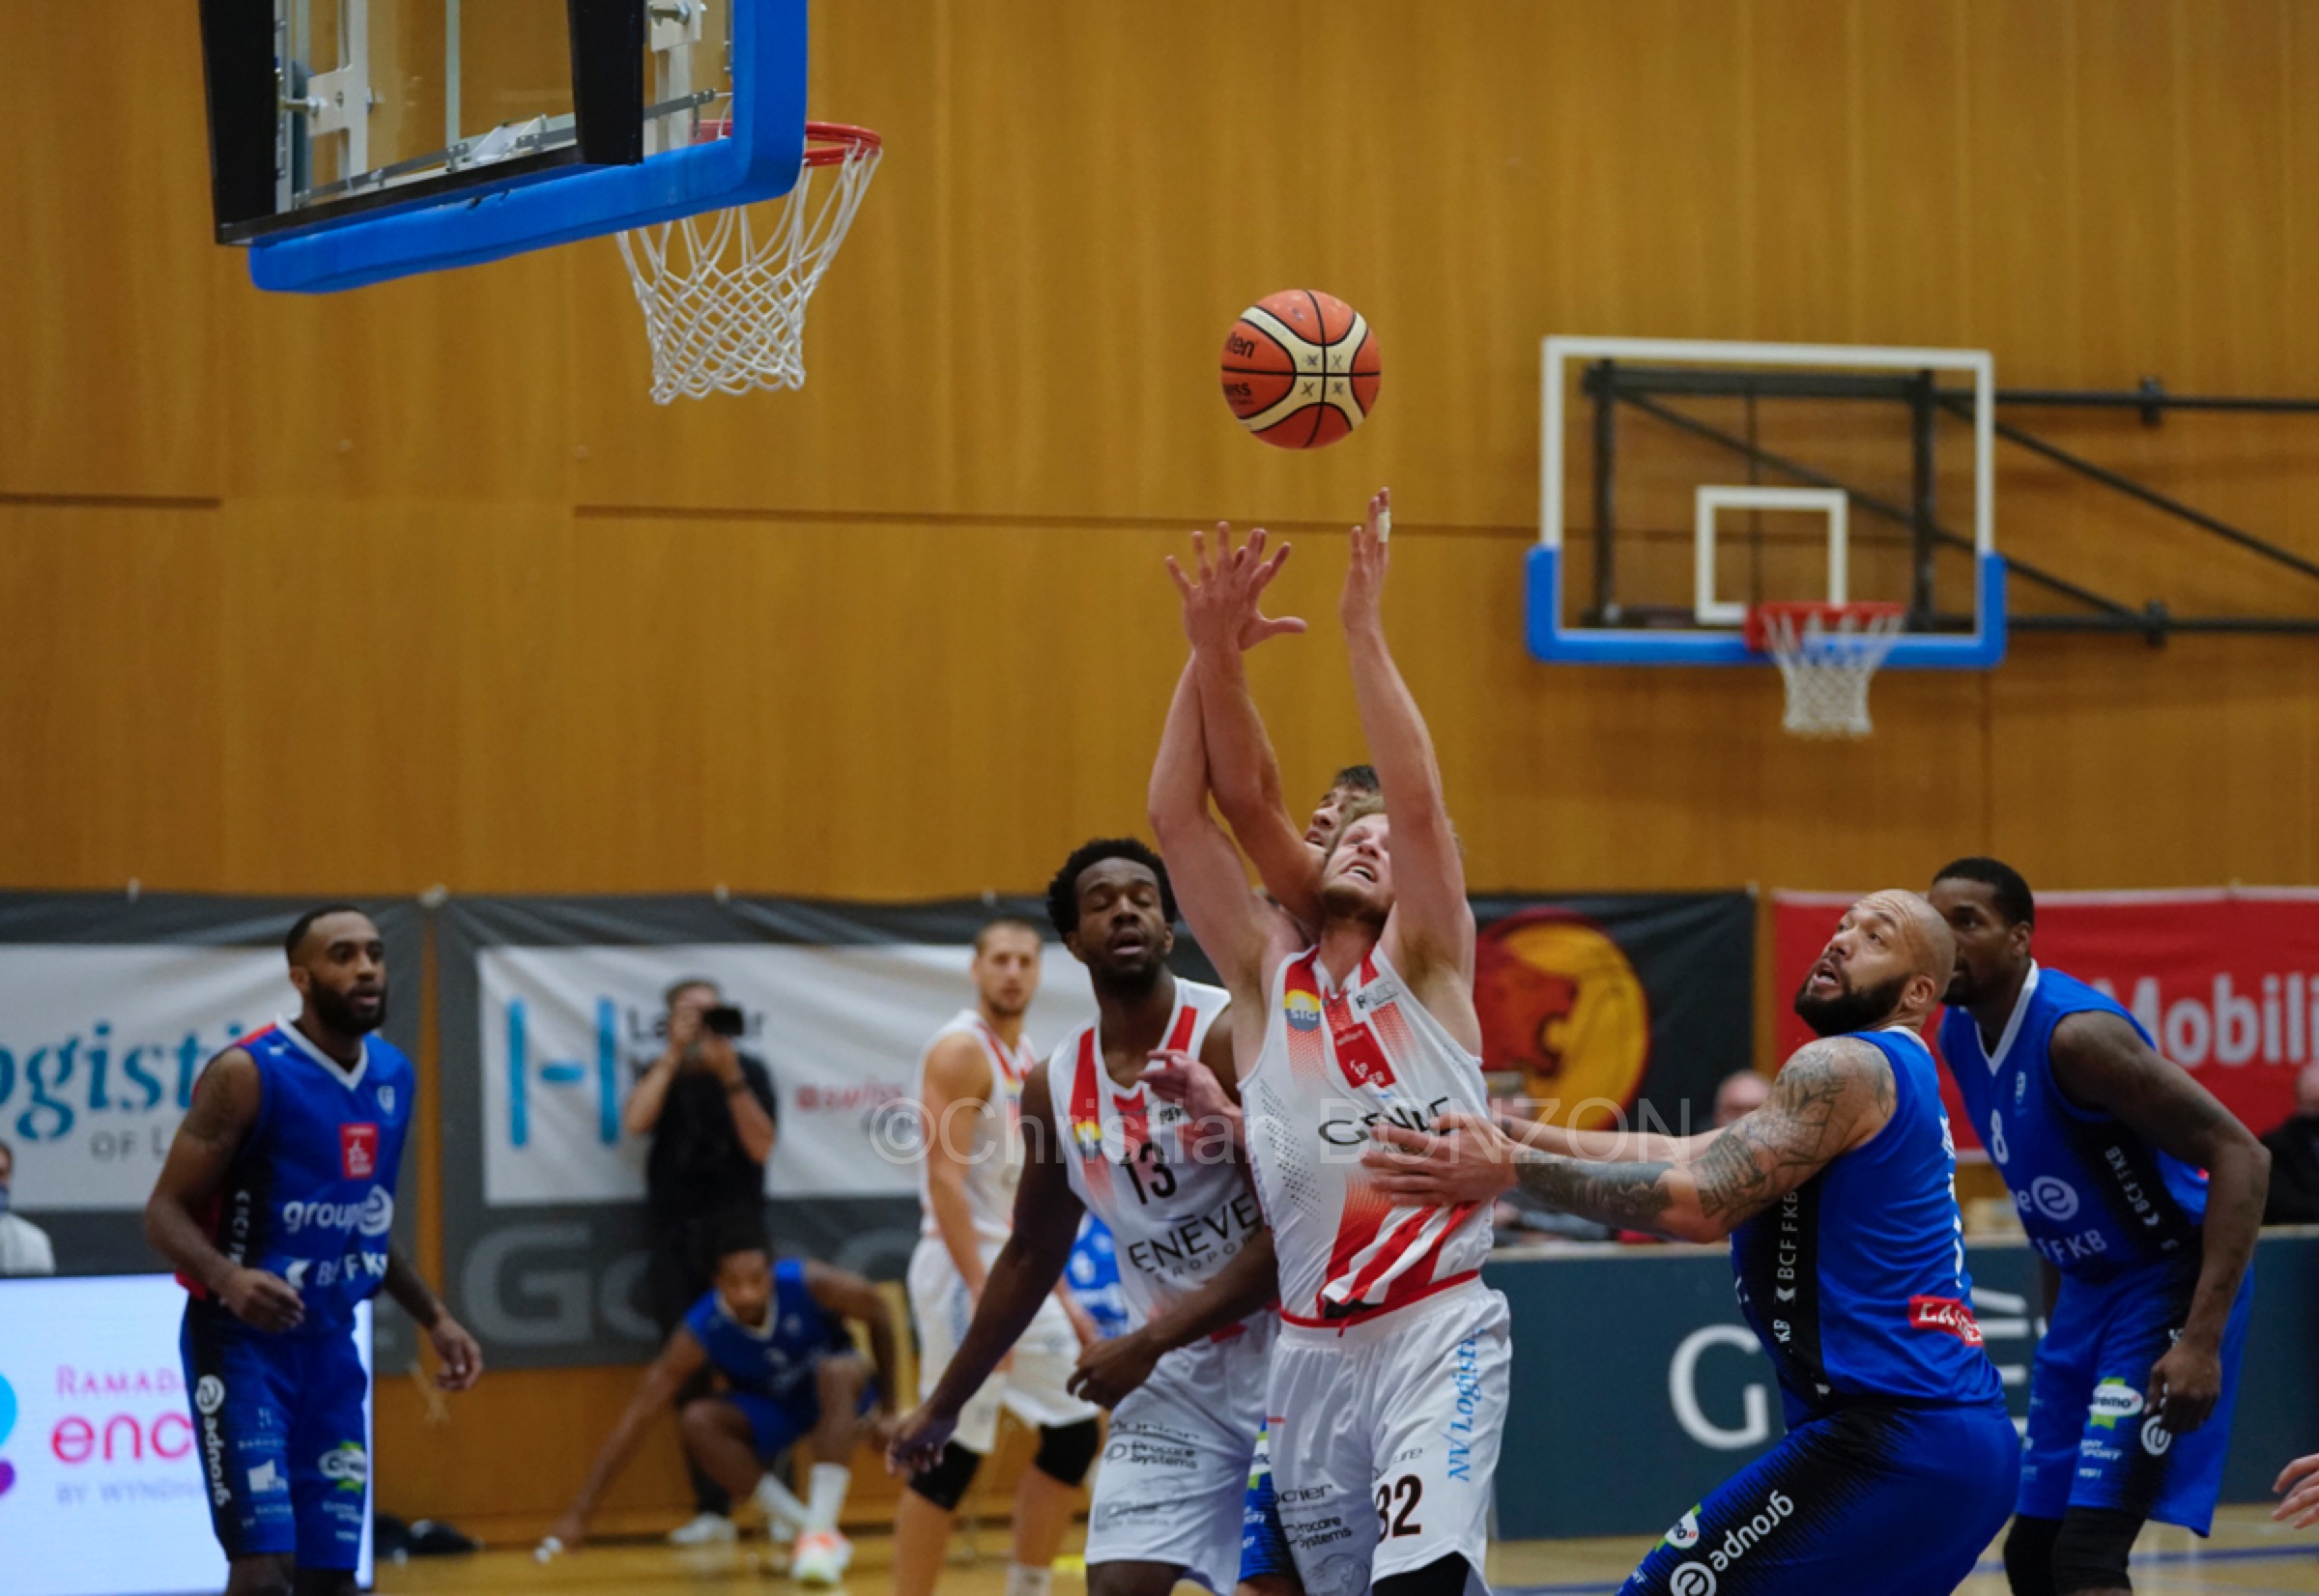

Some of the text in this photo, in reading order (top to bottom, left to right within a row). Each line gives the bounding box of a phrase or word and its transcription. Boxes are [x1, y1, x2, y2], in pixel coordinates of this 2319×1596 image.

[1990, 1108, 2009, 1164] 8
[1119, 1141, 1177, 1206] 13
[1776, 1238, 1797, 1280] BCF
[1707, 1489, 1795, 1573] groupe
